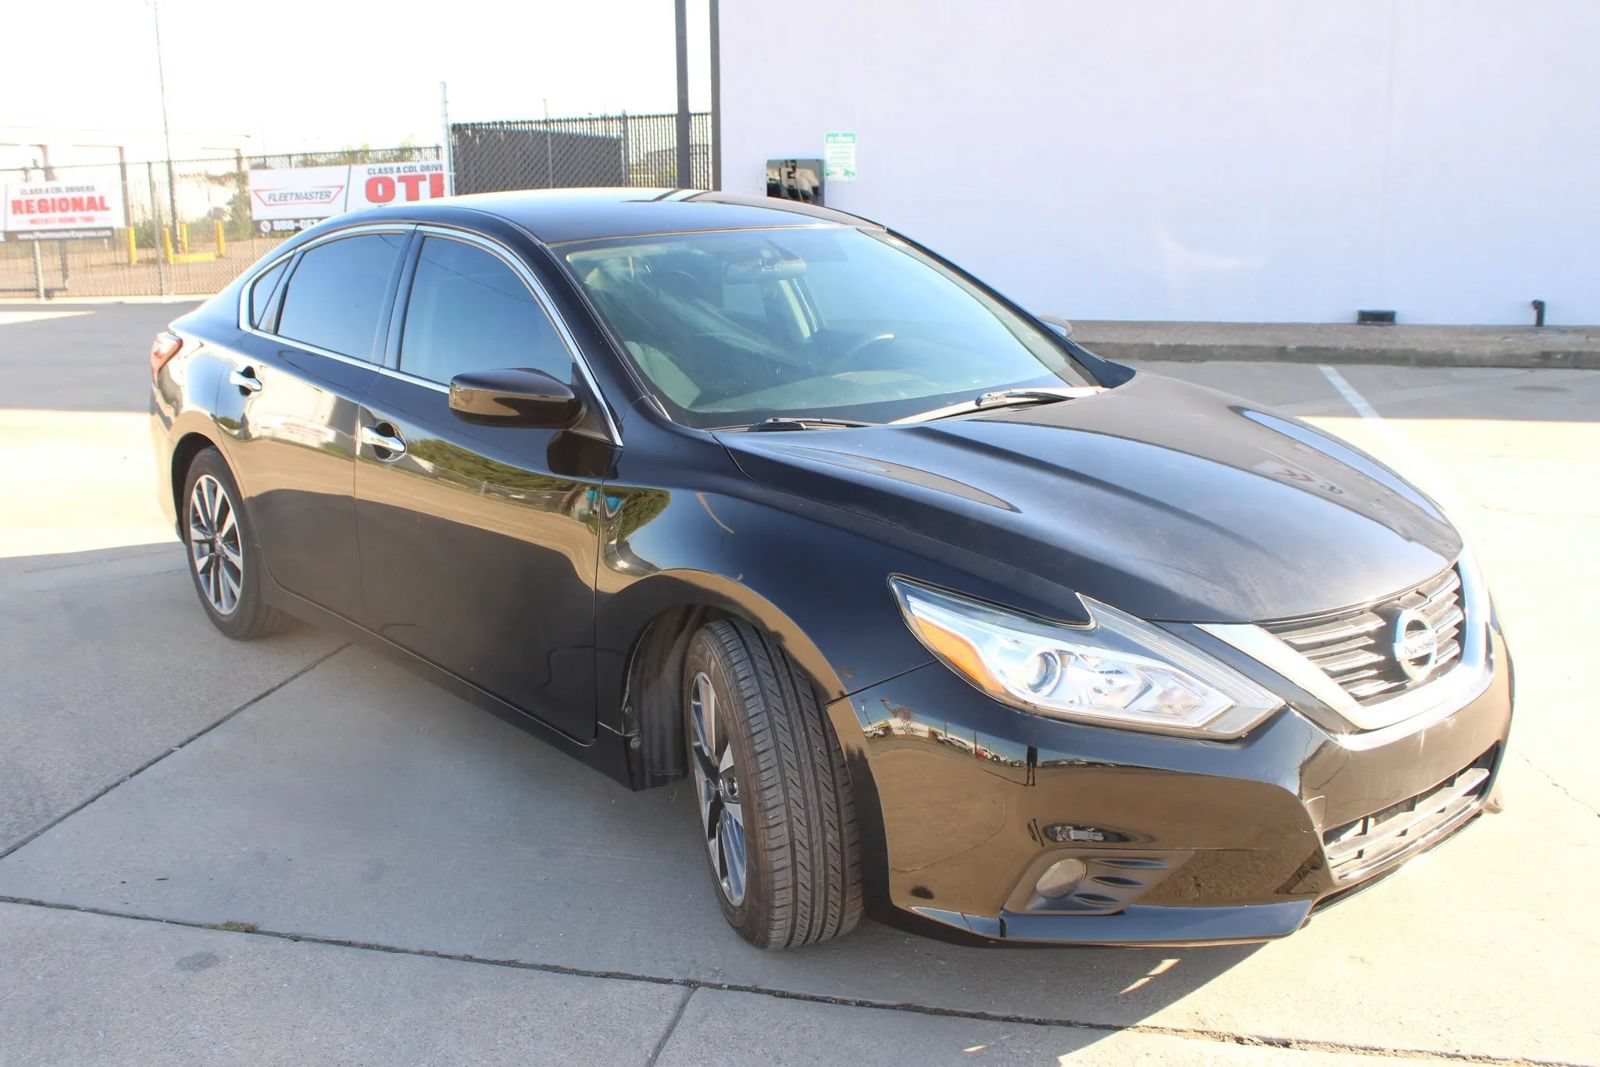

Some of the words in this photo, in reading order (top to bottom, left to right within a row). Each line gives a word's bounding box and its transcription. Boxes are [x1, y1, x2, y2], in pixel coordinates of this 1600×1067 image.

[368, 166, 393, 175] CLASS
[396, 165, 402, 174] A
[403, 164, 418, 173] CDL
[268, 190, 332, 202] FLEETMASTER
[11, 195, 110, 215] REGIONAL
